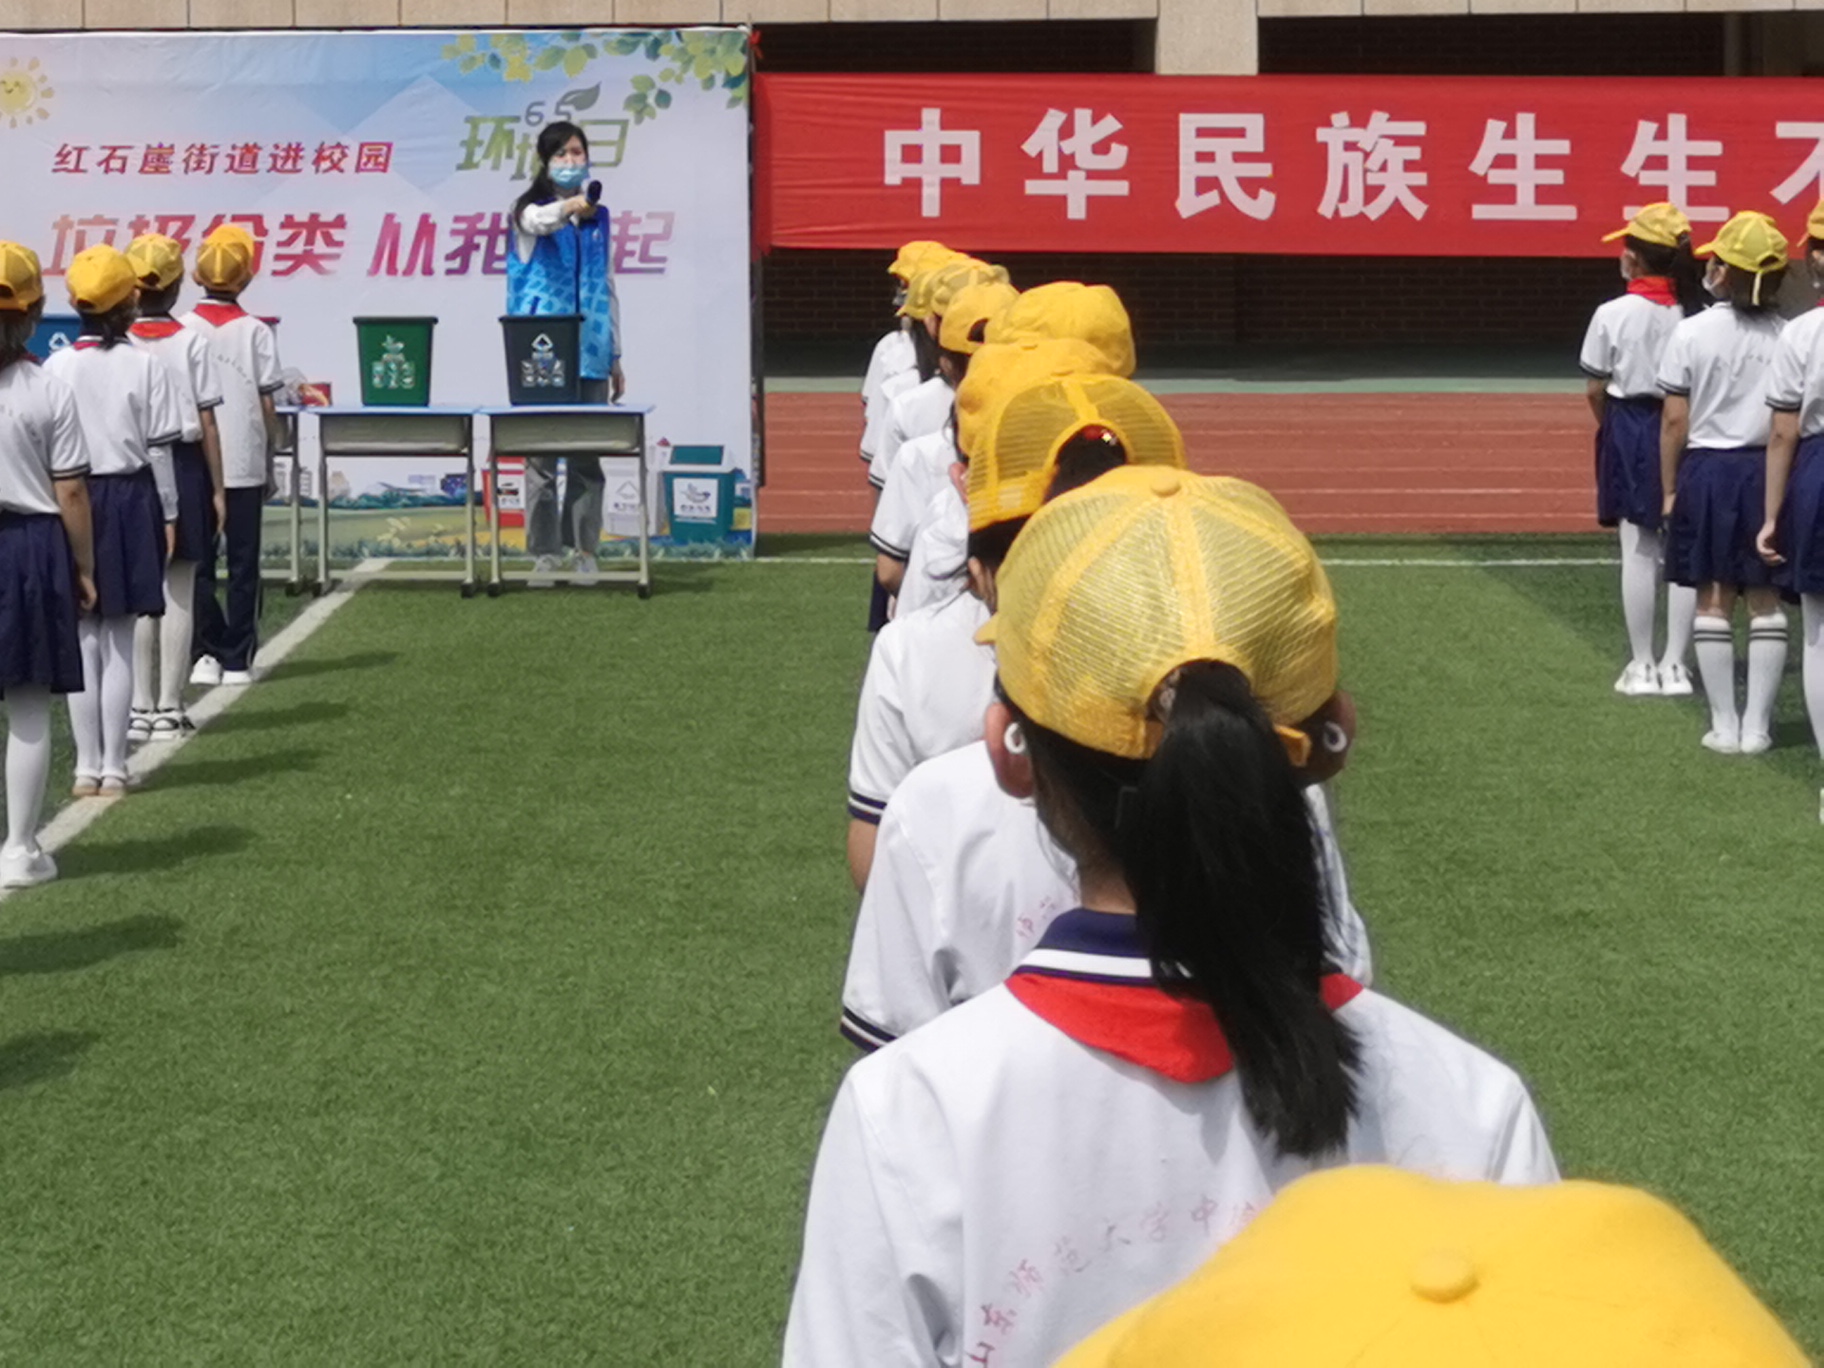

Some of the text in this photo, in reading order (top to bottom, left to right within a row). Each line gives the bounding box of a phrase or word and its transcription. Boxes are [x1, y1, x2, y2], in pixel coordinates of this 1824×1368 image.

[51, 141, 394, 175] 红石崖街道进校园
[366, 211, 675, 276] 从我起
